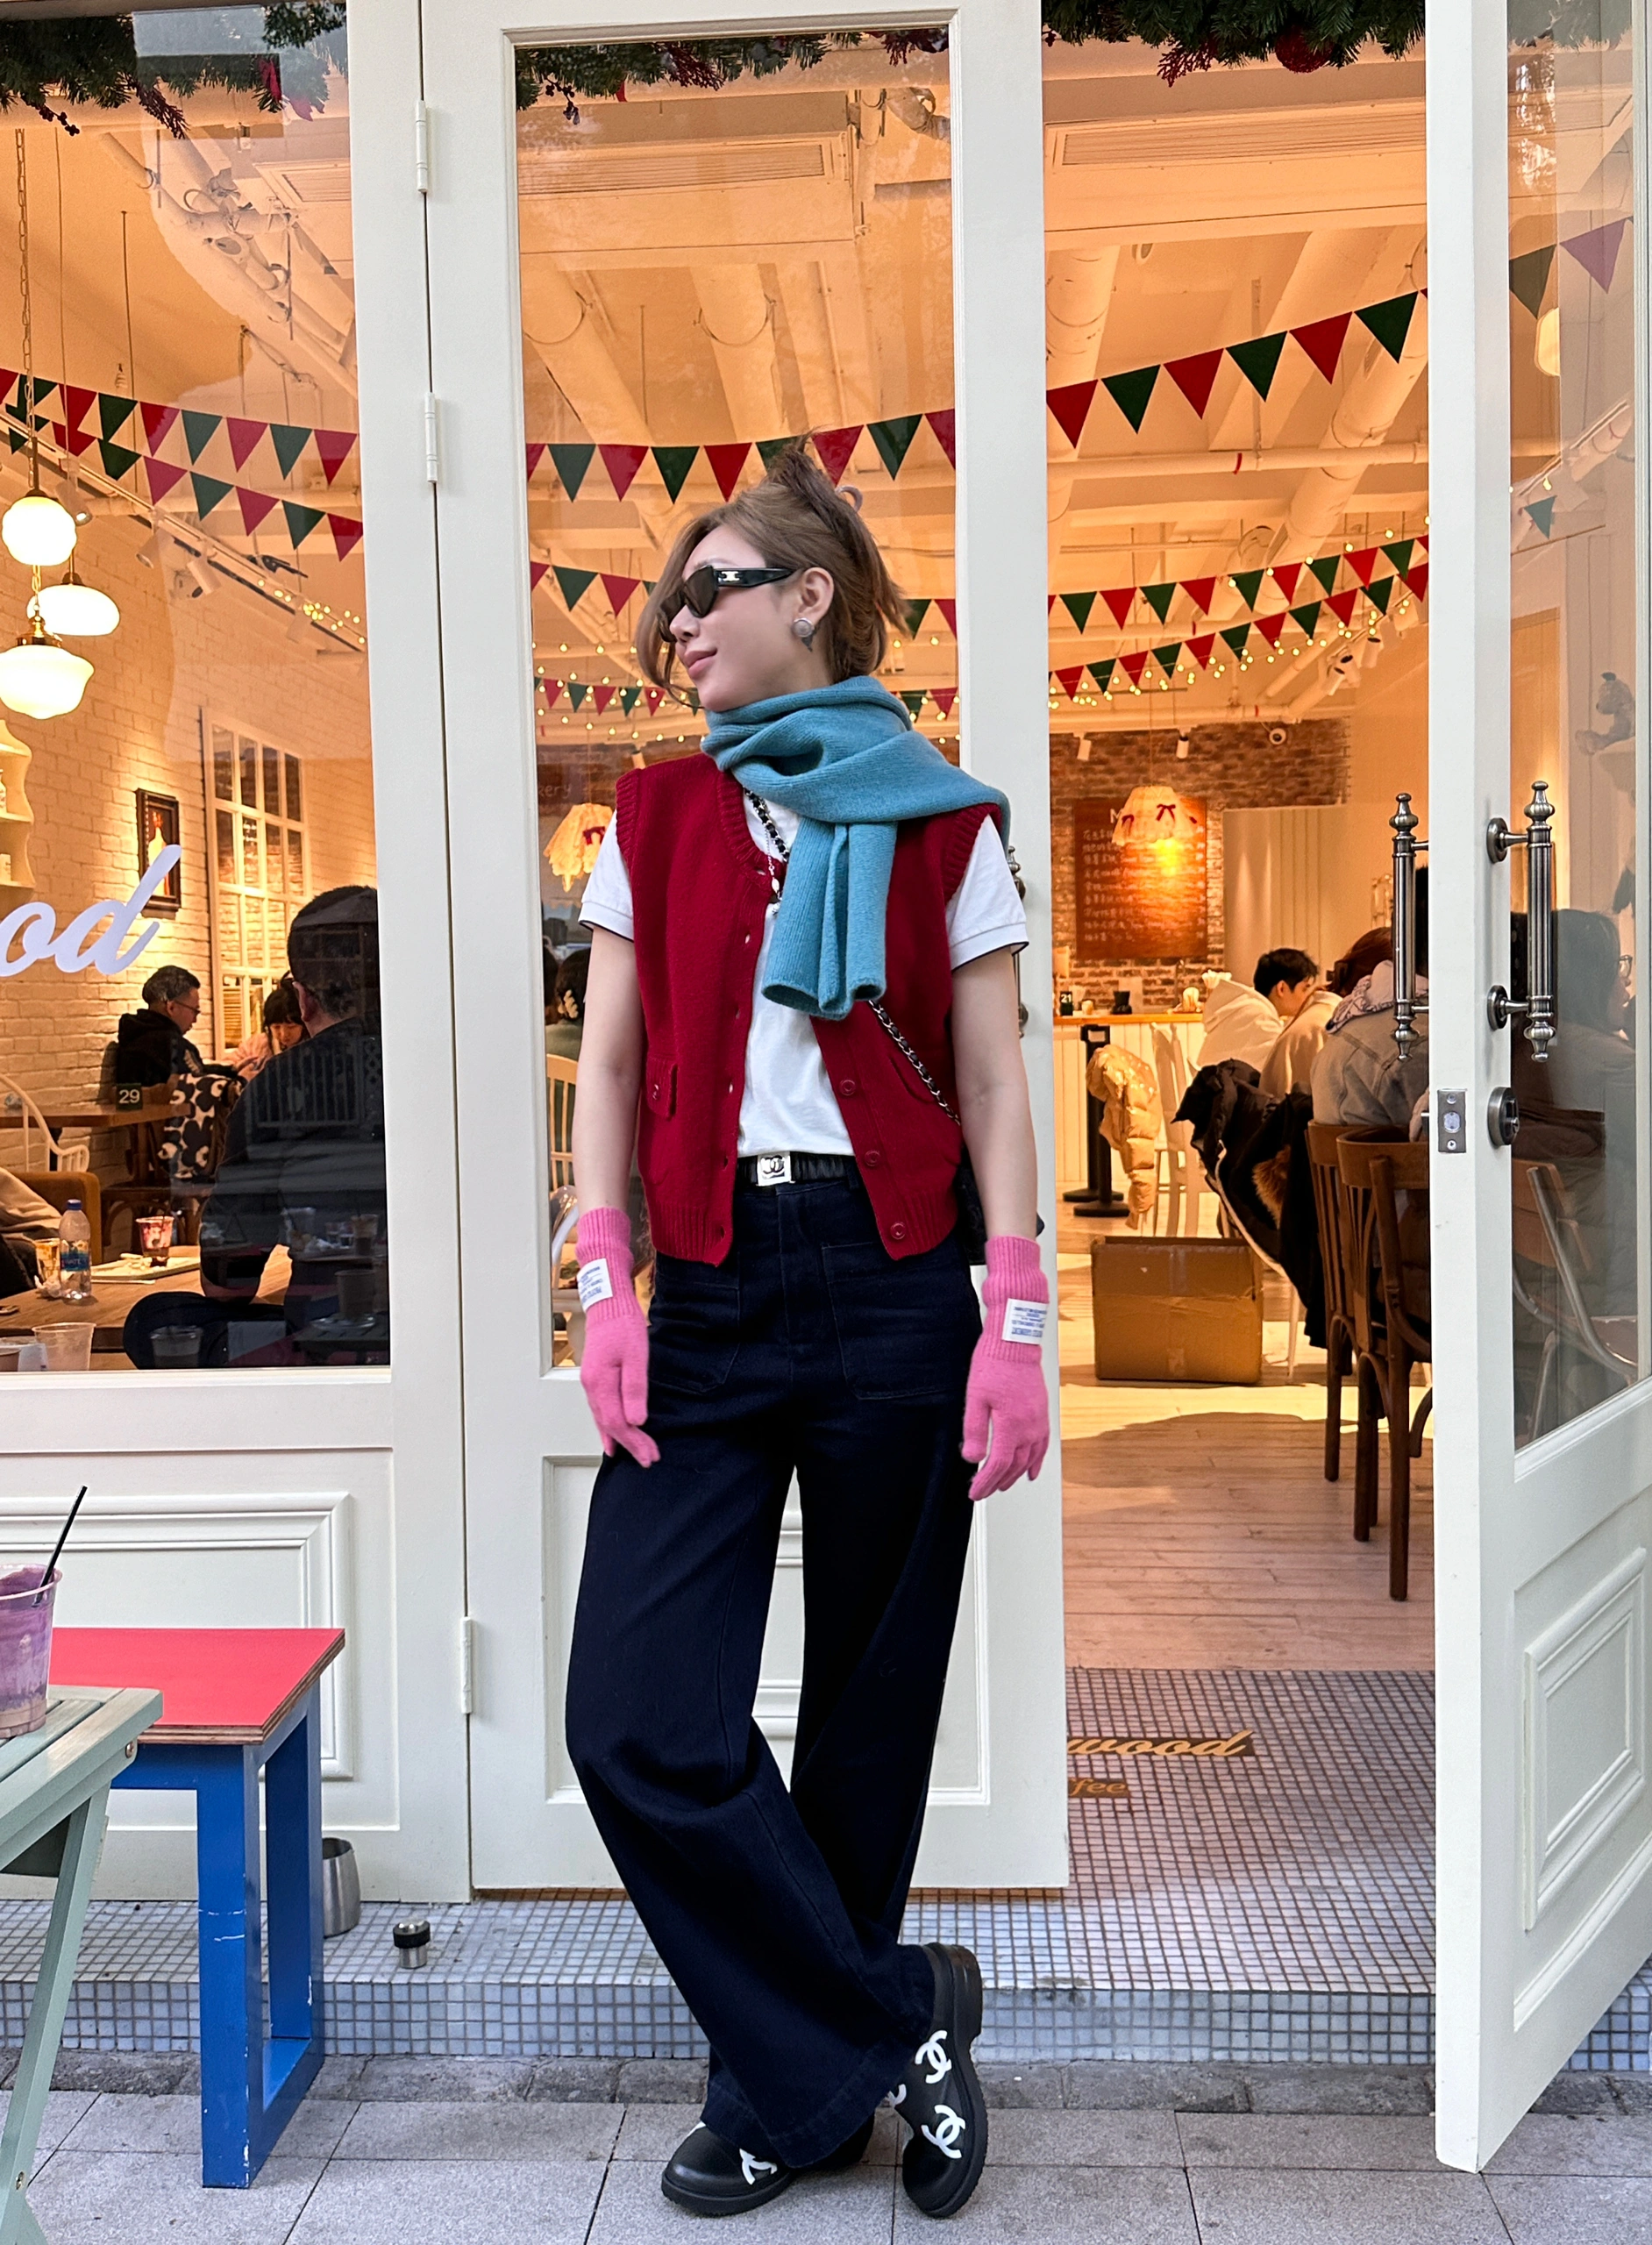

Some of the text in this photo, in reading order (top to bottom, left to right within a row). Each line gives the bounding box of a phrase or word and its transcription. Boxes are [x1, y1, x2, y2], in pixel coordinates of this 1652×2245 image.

[0, 845, 182, 977] od
[1061, 994, 1072, 1003] 21
[119, 1089, 140, 1103] 29
[1067, 1728, 1253, 1756] wood
[1068, 1778, 1126, 1796] fee
